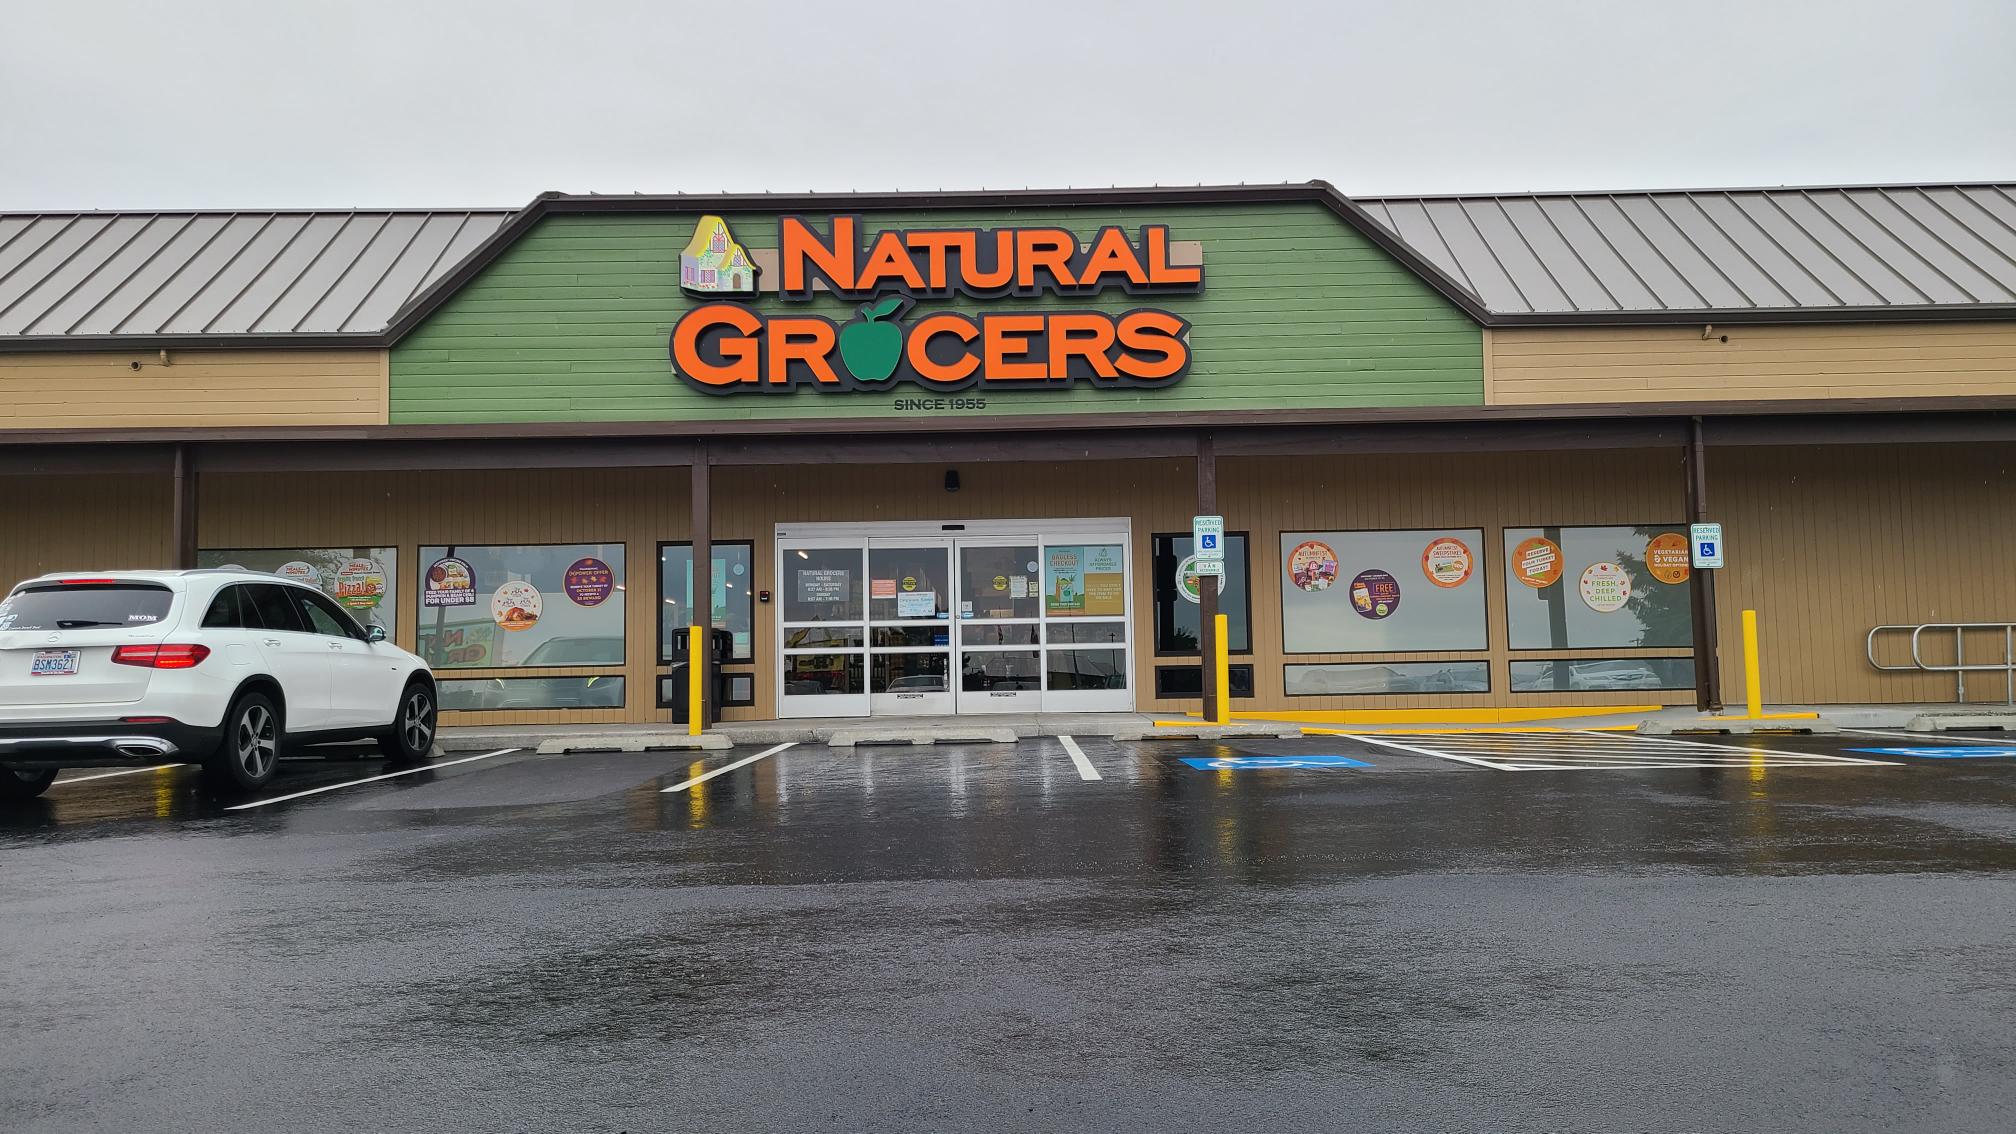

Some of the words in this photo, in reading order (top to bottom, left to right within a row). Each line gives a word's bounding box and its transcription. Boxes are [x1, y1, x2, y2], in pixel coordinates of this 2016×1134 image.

[782, 216, 1201, 291] NATURAL
[673, 302, 1188, 385] GROCERS
[894, 399, 945, 411] SINCE
[949, 398, 987, 410] 1955
[1527, 547, 1549, 557] RESERVE
[1522, 559, 1536, 567] YOUR
[1536, 555, 1554, 563] TURKEY
[338, 581, 364, 596] Pizza!
[1375, 583, 1393, 592] FREE
[128, 614, 158, 622] MOM
[34, 659, 74, 671] BSM3621
